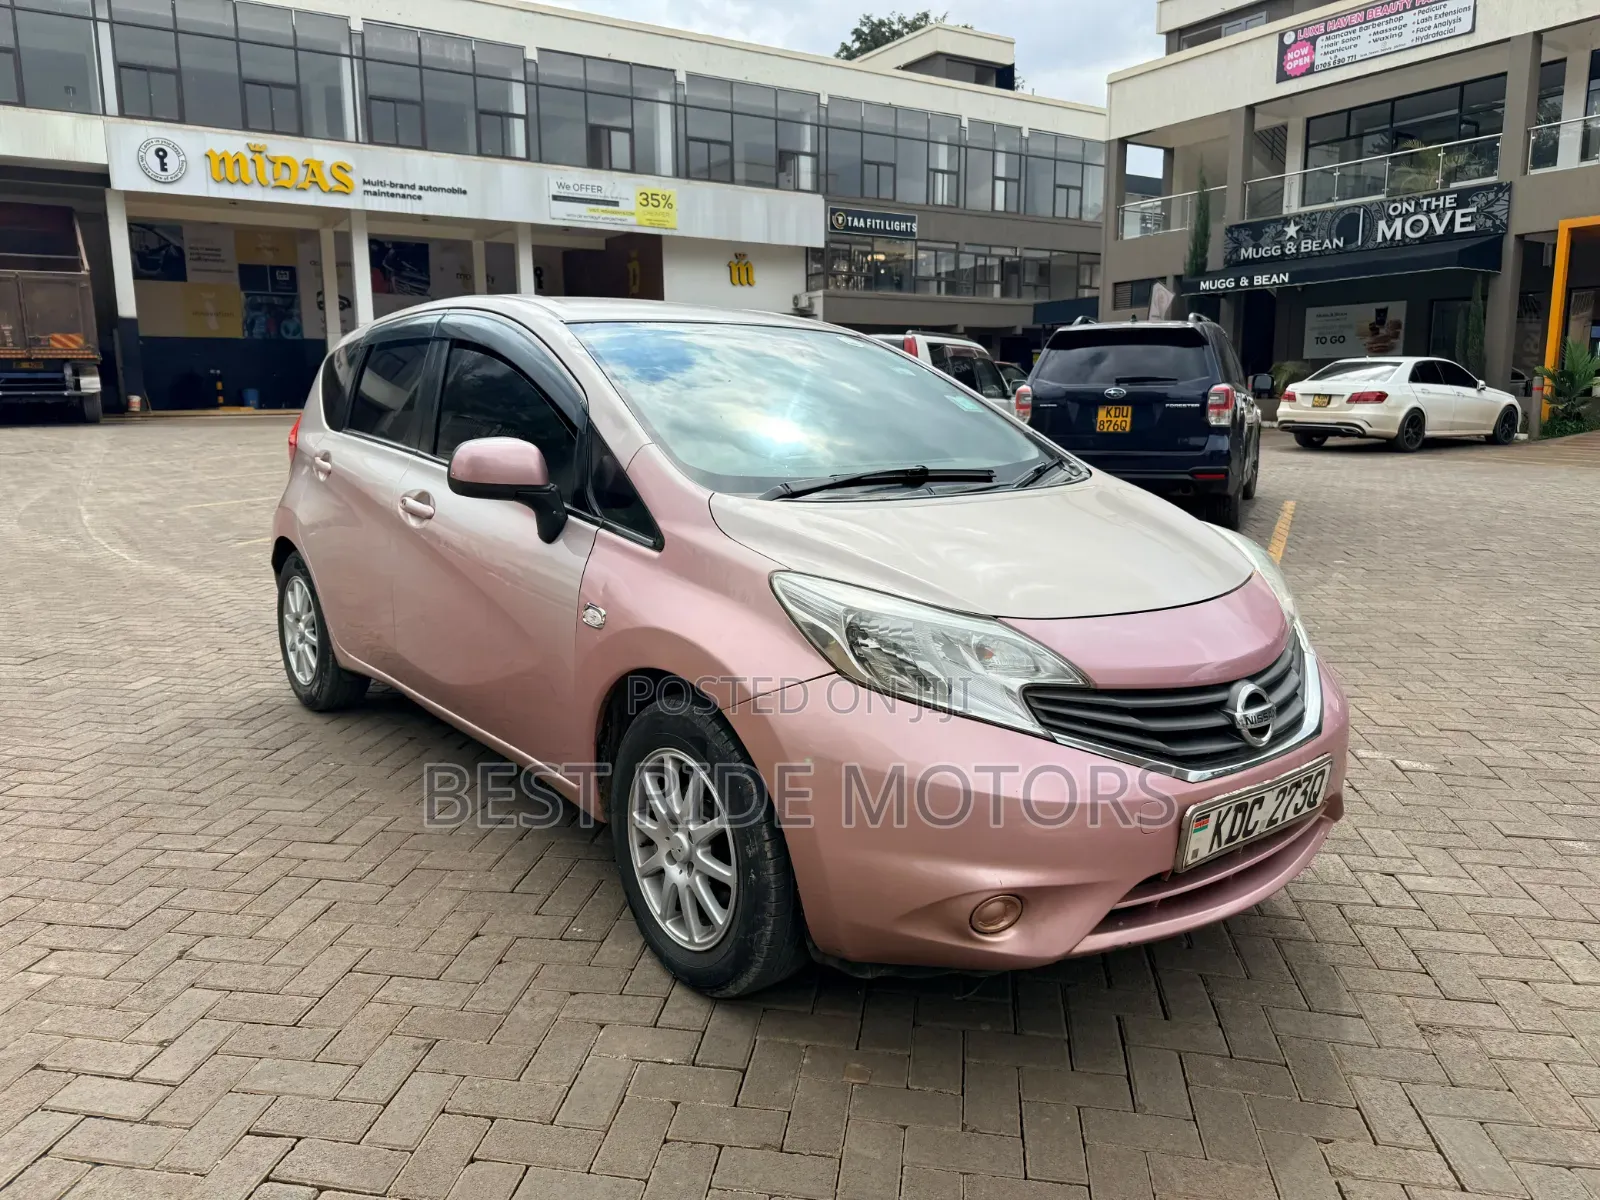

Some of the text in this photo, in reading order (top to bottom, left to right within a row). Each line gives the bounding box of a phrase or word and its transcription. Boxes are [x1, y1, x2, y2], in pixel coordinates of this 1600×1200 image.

[1416, 5, 1472, 25] Lash Extensions
[1417, 3, 1447, 16] Pedicure
[1297, 22, 1325, 40] LUXE
[1327, 10, 1364, 31] HAVEN
[1367, 0, 1412, 20] BEAUTY
[1415, 16, 1462, 34] Face Analysis
[1325, 15, 1404, 42] Mancave Barbershop
[1372, 23, 1407, 37] Massage
[1415, 26, 1456, 44] Hydrafacial
[1324, 35, 1361, 49] Hair Salon
[1372, 31, 1403, 44] Waxing
[1287, 46, 1309, 61] NOW
[1322, 43, 1357, 56] Manicure
[1286, 55, 1310, 70] OPEN
[362, 178, 468, 196] Multi-brand automobile
[363, 188, 423, 201] maintenance
[556, 181, 603, 194] We OFFER
[639, 191, 674, 210] 35%
[1388, 193, 1458, 216] ON THE
[885, 220, 918, 233] LIGHTS
[1376, 206, 1478, 243] MOVE
[1240, 236, 1344, 260] MUGG & BEAN
[1199, 272, 1290, 291] MUGG & BEAN
[1314, 335, 1346, 345] TO GO
[1105, 405, 1129, 419] KDU
[1098, 419, 1128, 432] 876Q
[1208, 768, 1326, 853] KDC 273Q
